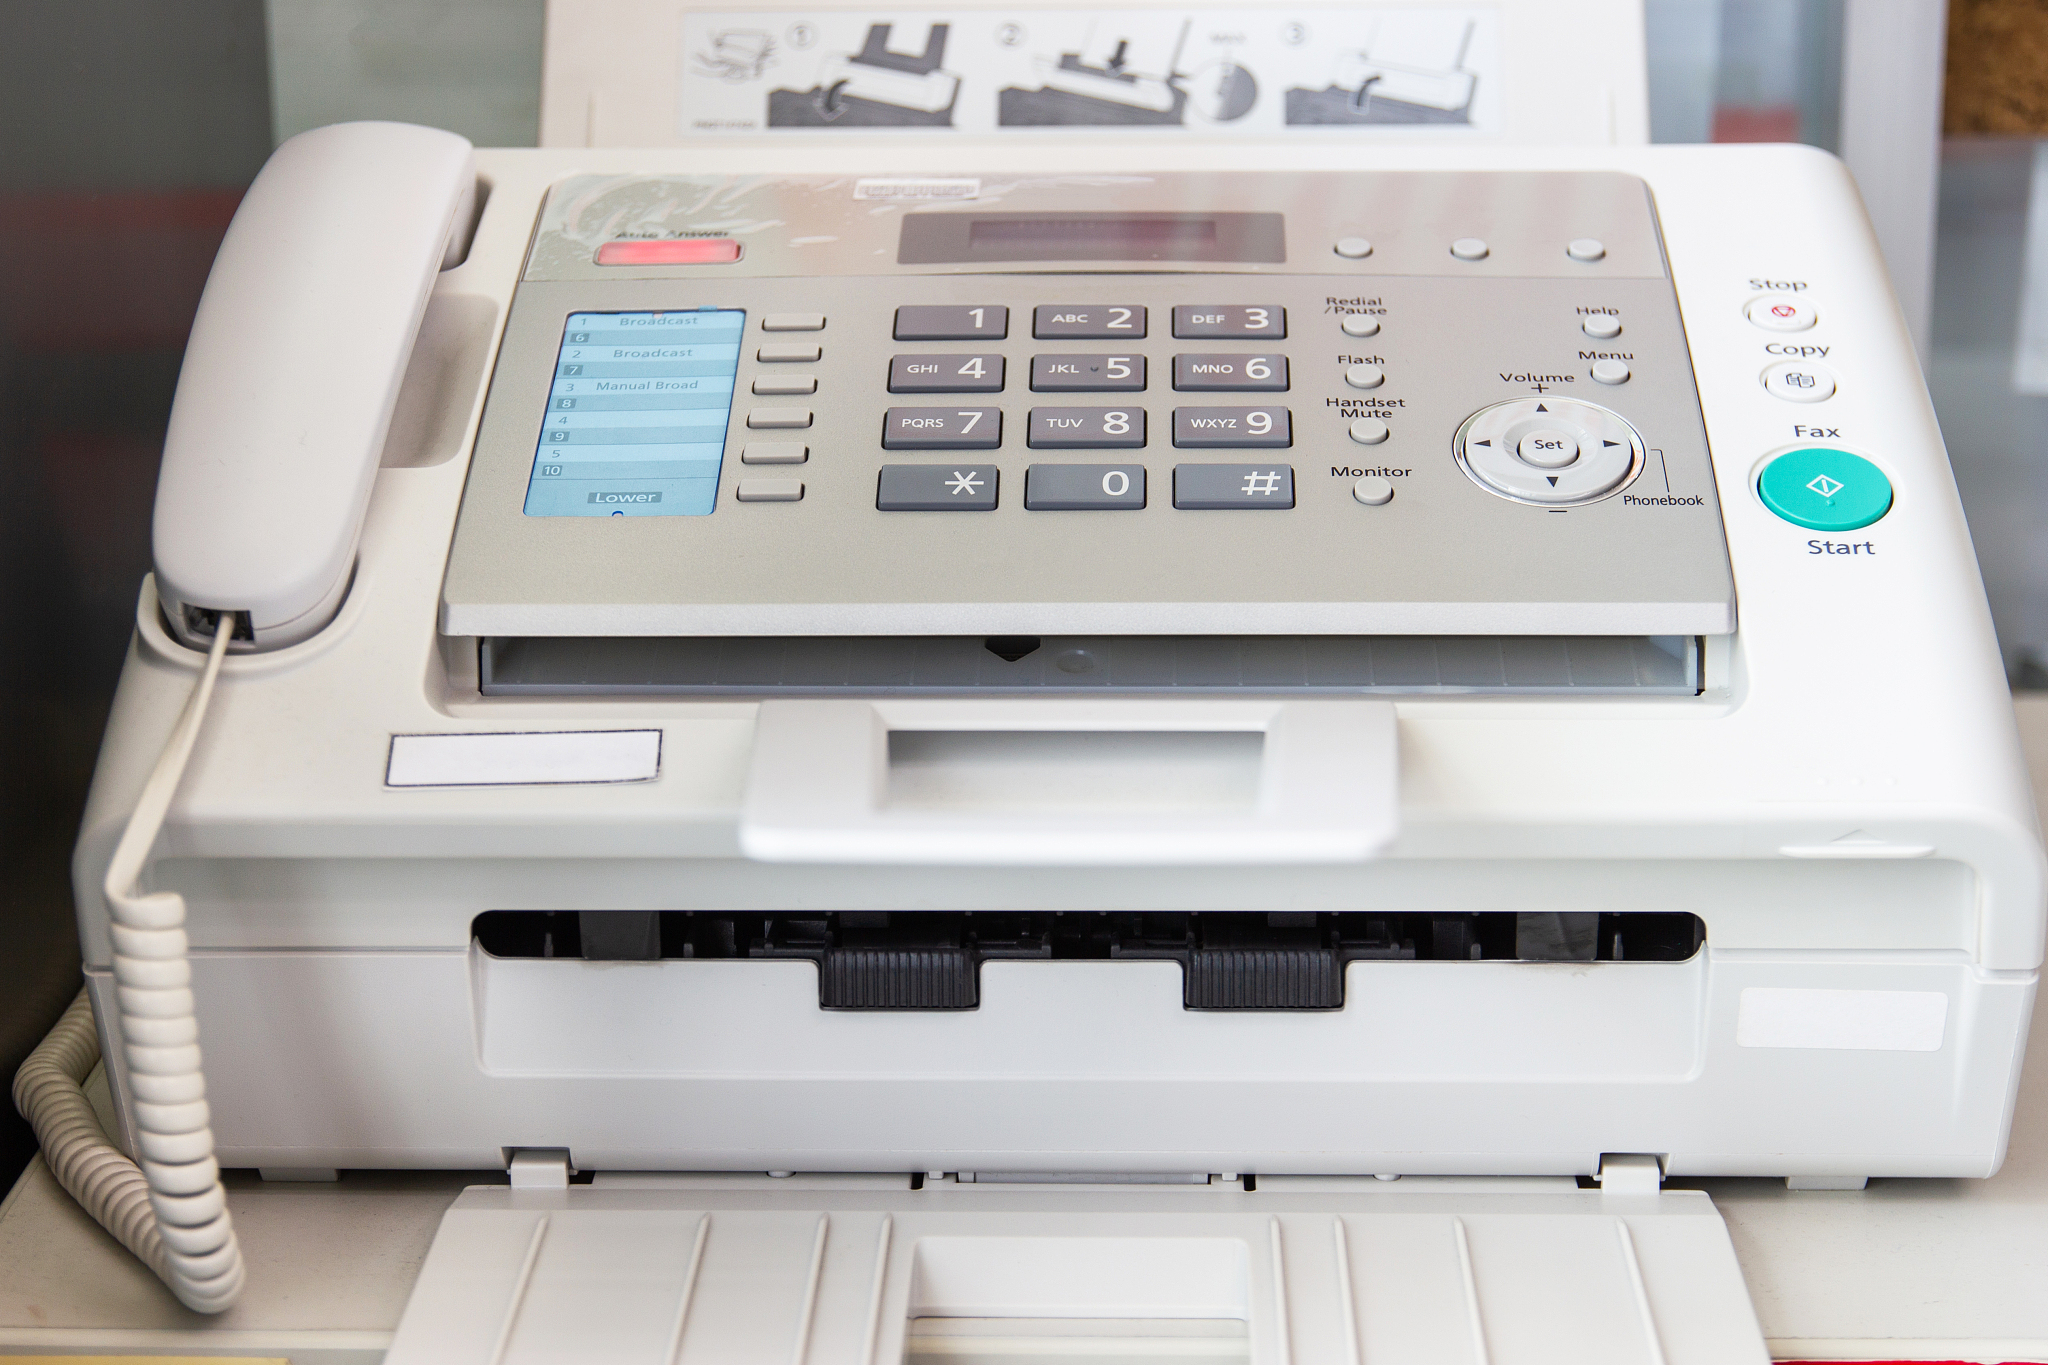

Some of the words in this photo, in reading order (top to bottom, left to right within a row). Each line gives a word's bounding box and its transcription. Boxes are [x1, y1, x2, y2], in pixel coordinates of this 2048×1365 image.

[1749, 279, 1808, 292] Stop
[1325, 297, 1382, 306] Redial
[1325, 306, 1388, 316] /Pause
[1576, 307, 1619, 317] Help
[581, 318, 587, 326] 1
[619, 316, 698, 326] Broadcast
[967, 308, 983, 328] 1
[1051, 313, 1089, 324] ABC
[1106, 308, 1133, 328] 2
[1192, 314, 1225, 324] DEF
[1245, 308, 1269, 328] 3
[575, 333, 585, 343] 6
[572, 349, 581, 359] 2
[613, 347, 693, 358] Broadcast
[1765, 343, 1830, 357] Copy
[1337, 355, 1385, 365] Flash
[1578, 351, 1634, 361] Menu
[569, 366, 578, 375] 7
[907, 364, 938, 374] GHI
[957, 358, 986, 379] 4
[1048, 364, 1079, 374] JKL
[1106, 358, 1131, 379] 5
[1192, 364, 1234, 374] MNO
[1245, 358, 1271, 379] 6
[1500, 373, 1575, 383] Volume
[565, 383, 574, 392] 3
[596, 381, 650, 391] Manual
[655, 380, 699, 390] Broad
[562, 398, 571, 408] 8
[1326, 398, 1406, 408] Handset
[1340, 408, 1392, 419] Mute
[558, 416, 568, 425] 4
[901, 418, 944, 430] PQRS
[957, 411, 983, 434] 7
[1046, 418, 1083, 428] TUV
[1102, 411, 1130, 434] 8
[1191, 418, 1237, 429] WXYZ
[1246, 411, 1272, 434] 9
[555, 432, 564, 441] 9
[1793, 425, 1841, 438] Fax
[1534, 439, 1564, 450] Set
[552, 449, 561, 459] 5
[544, 466, 560, 475] 10
[1331, 466, 1412, 477] Monitor
[1102, 471, 1130, 496] 0
[1241, 471, 1281, 495] #
[595, 492, 656, 503] Lower
[1623, 494, 1705, 507] Phonebook
[1807, 540, 1876, 555] Start
